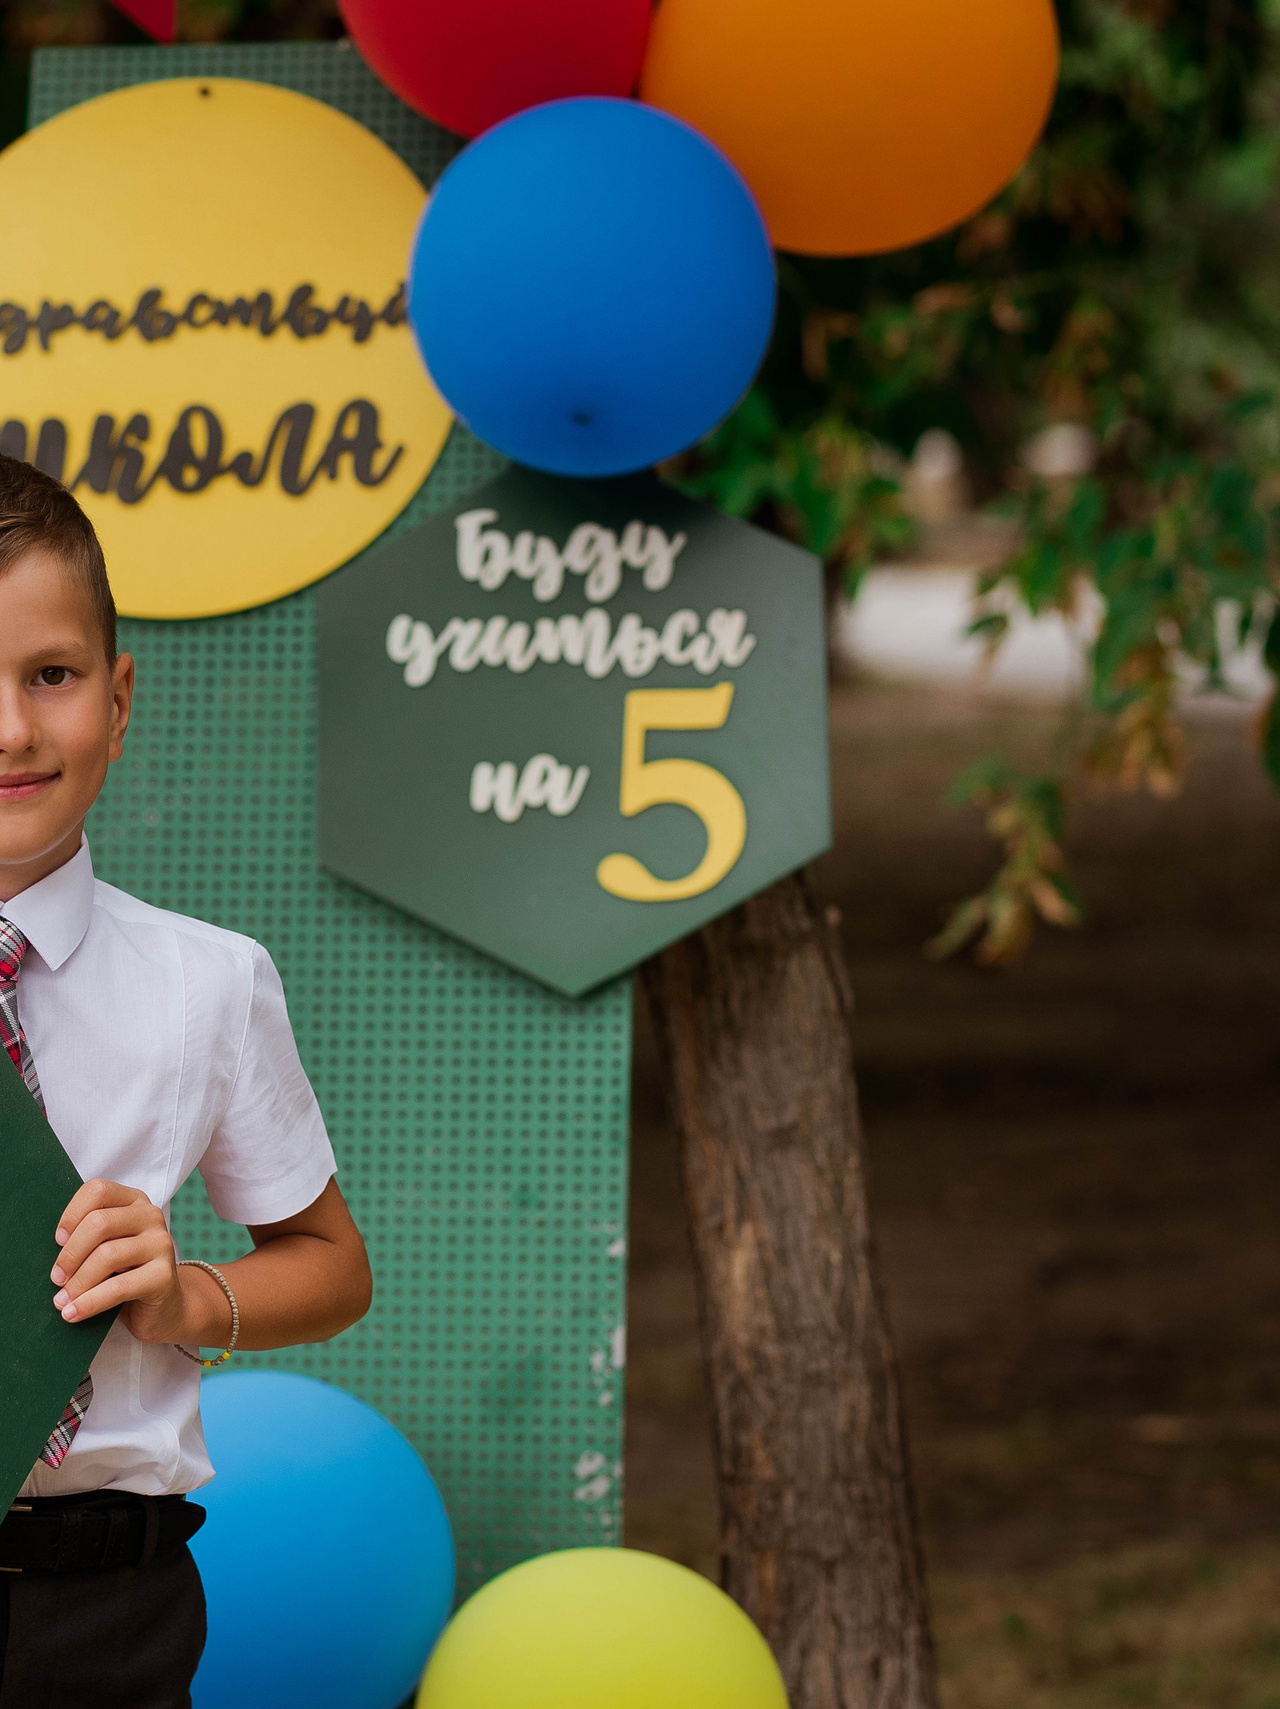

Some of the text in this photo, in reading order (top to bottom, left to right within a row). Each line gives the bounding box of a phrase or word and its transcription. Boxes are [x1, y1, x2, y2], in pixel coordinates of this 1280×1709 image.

[455, 508, 687, 602] Буду
[386, 607, 757, 688] учиться
[469, 682, 748, 902] на 5
